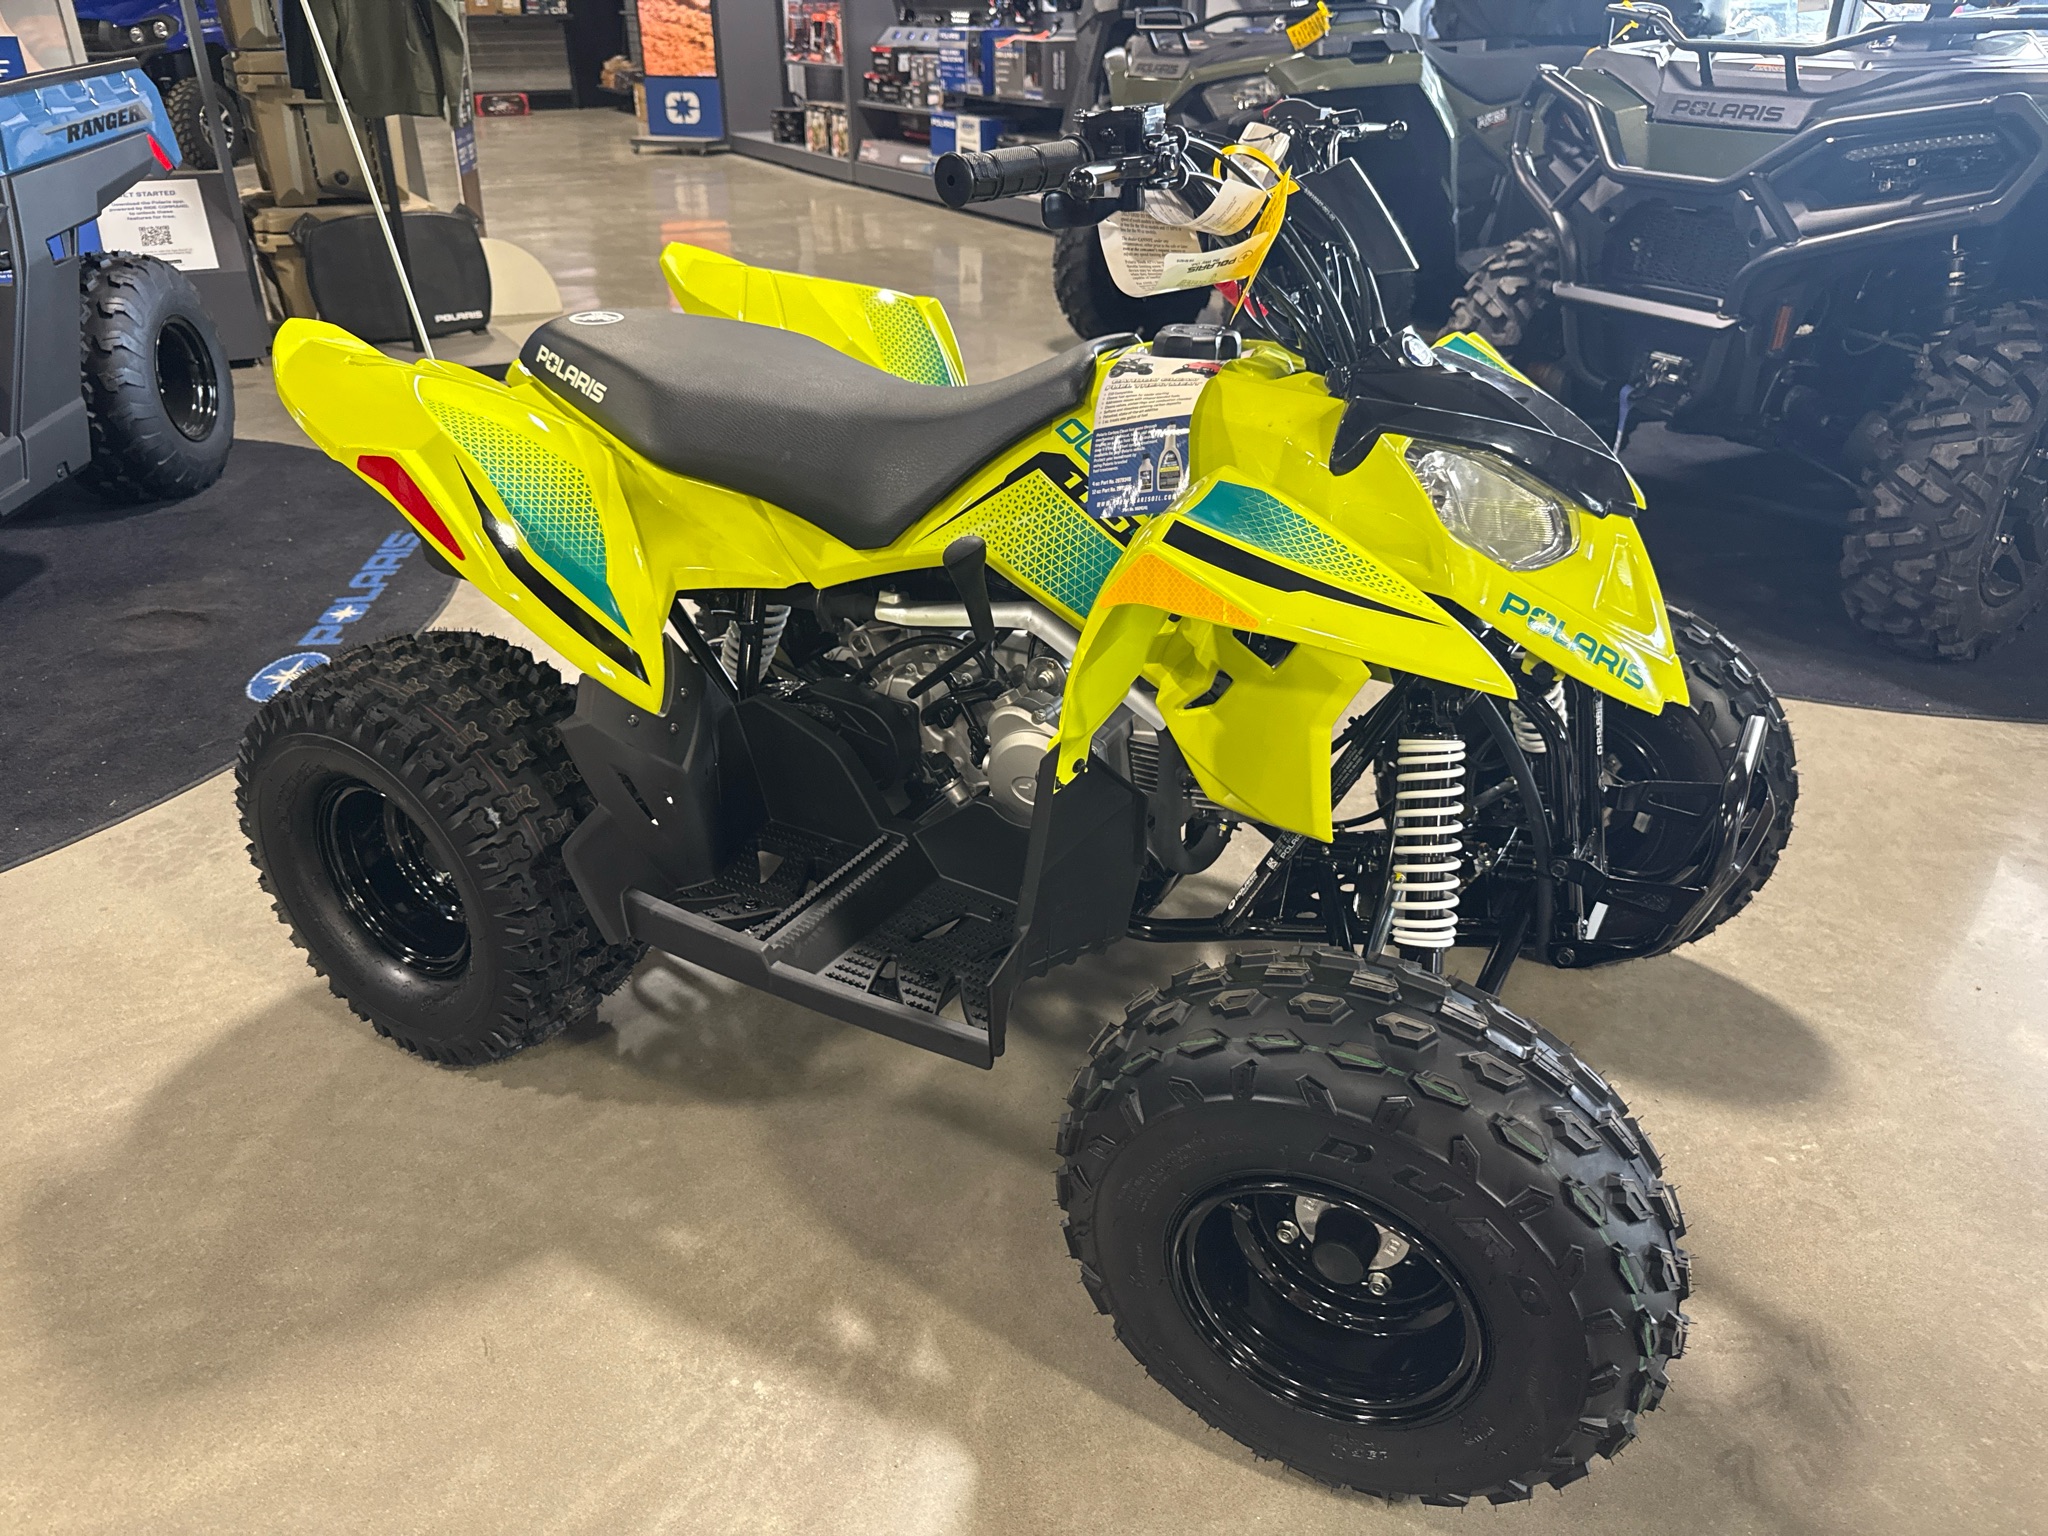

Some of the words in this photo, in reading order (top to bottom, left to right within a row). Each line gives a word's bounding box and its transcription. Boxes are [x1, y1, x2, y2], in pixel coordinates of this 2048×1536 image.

[67, 104, 144, 144] RANGER
[1671, 99, 1786, 123] POLARIS
[135, 189, 176, 198] STARTED
[1187, 256, 1238, 274] POLARIS
[435, 310, 484, 324] POLARIS
[536, 344, 608, 404] POLARIS
[296, 530, 422, 646] POLARIS
[1500, 592, 1644, 691] POLARIS
[1234, 870, 1258, 901] POLARIS
